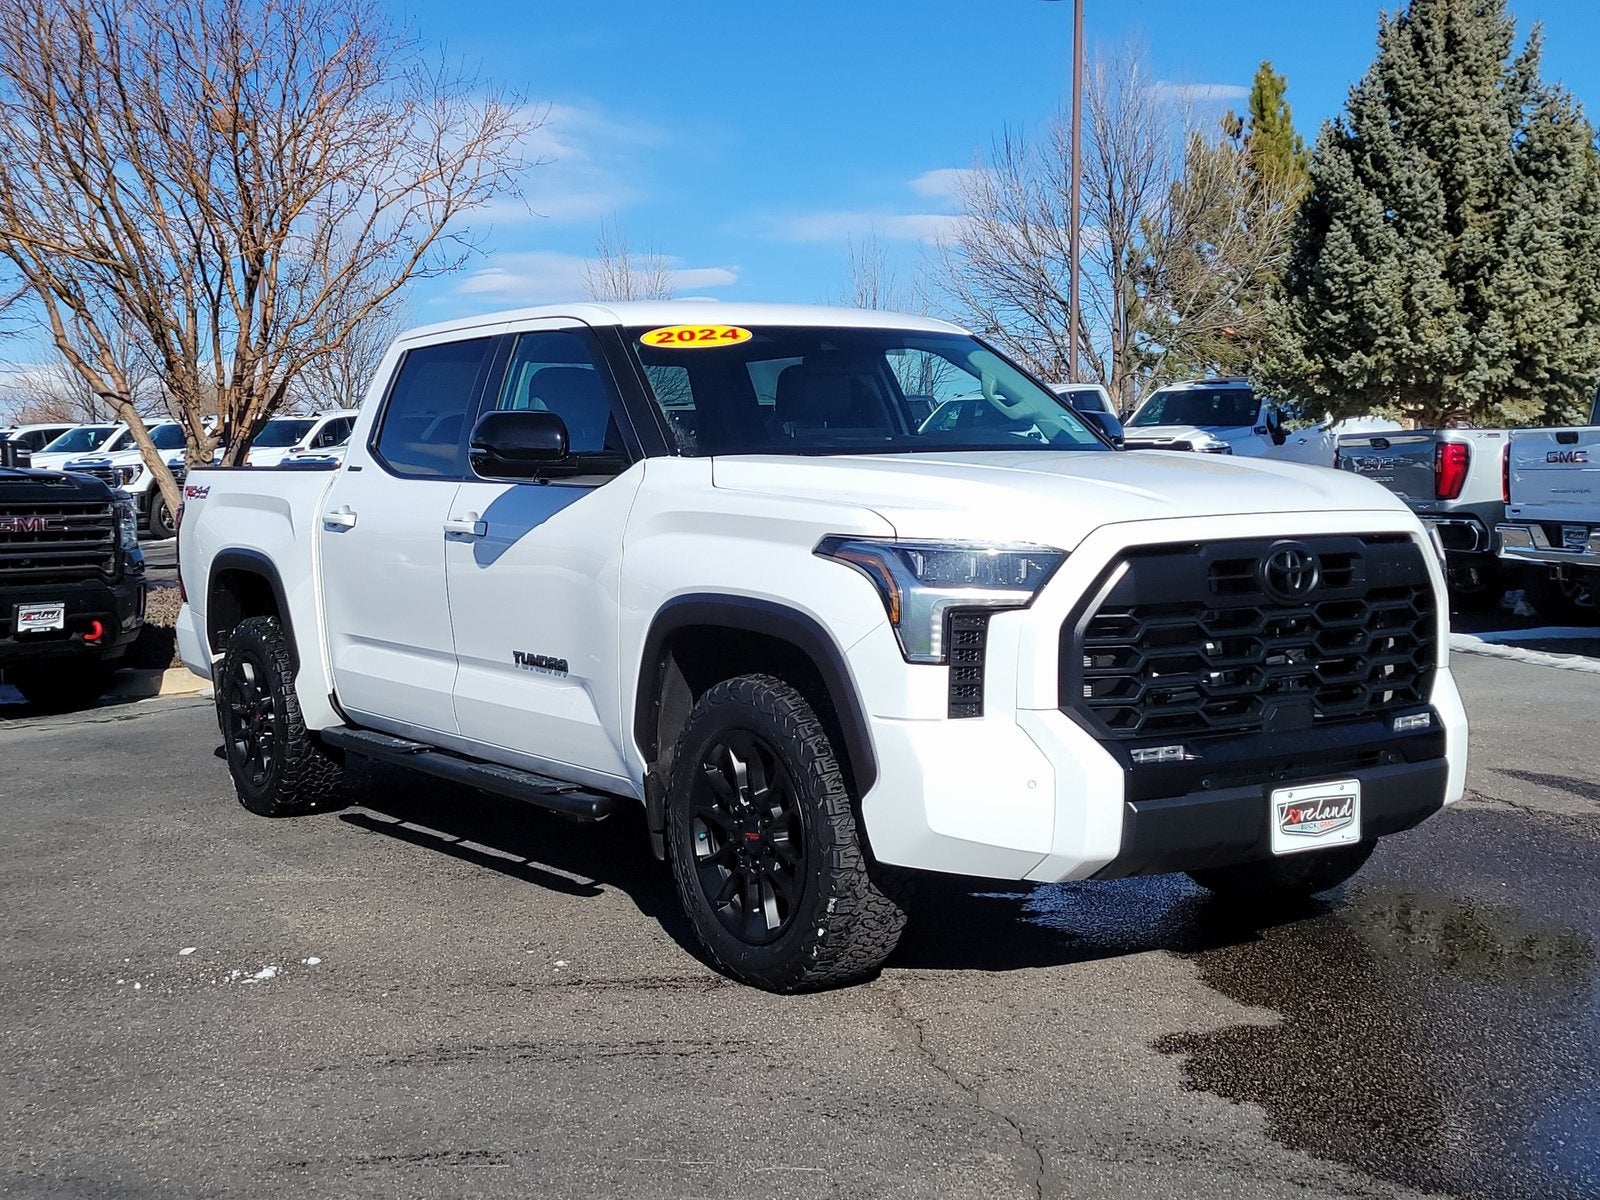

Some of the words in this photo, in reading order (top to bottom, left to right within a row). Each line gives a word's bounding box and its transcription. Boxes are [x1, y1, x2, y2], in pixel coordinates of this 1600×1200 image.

[656, 329, 740, 344] 2024
[1547, 451, 1588, 463] GMC
[0, 515, 68, 532] GMC
[513, 650, 568, 673] TUNDRA
[1280, 798, 1352, 825] Loveland
[1320, 820, 1334, 828] GMC
